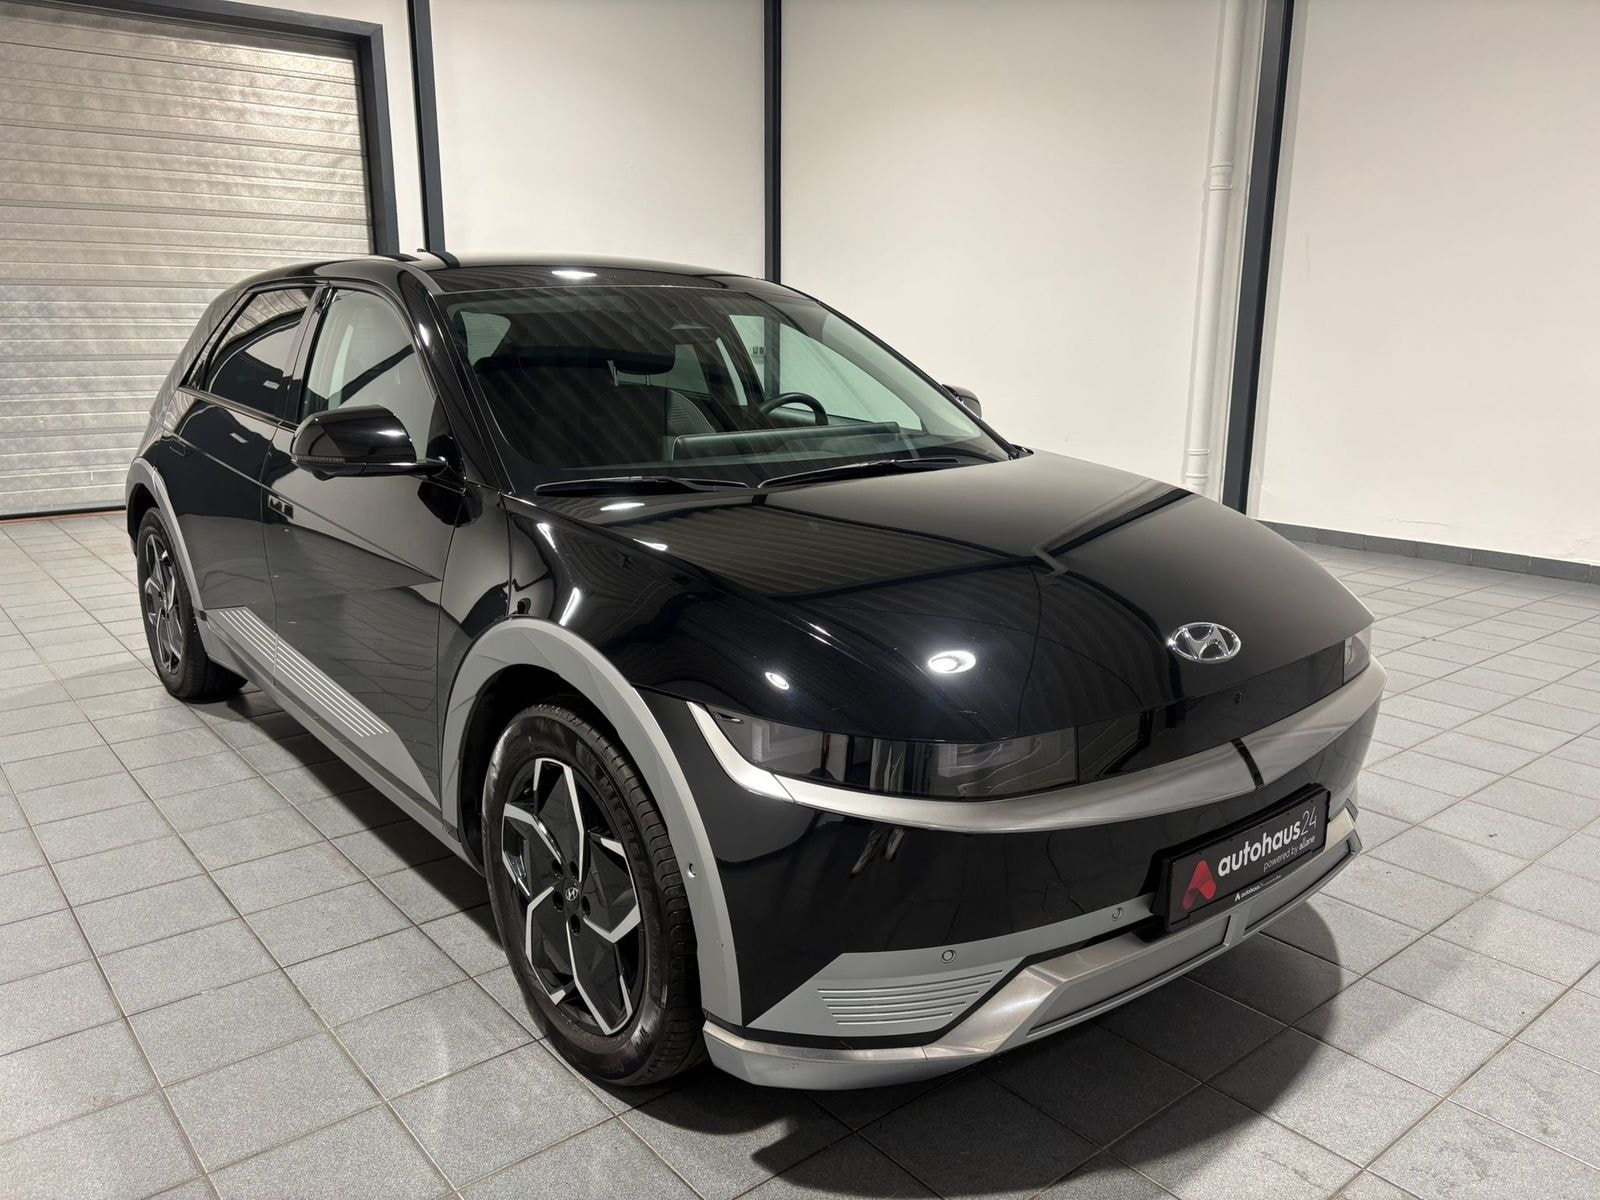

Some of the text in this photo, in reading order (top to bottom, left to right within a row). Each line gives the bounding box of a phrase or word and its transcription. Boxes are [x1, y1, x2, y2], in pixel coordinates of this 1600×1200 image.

[1217, 806, 1317, 877] autohaus24
[1263, 849, 1291, 872] powered
[1290, 843, 1298, 855] by
